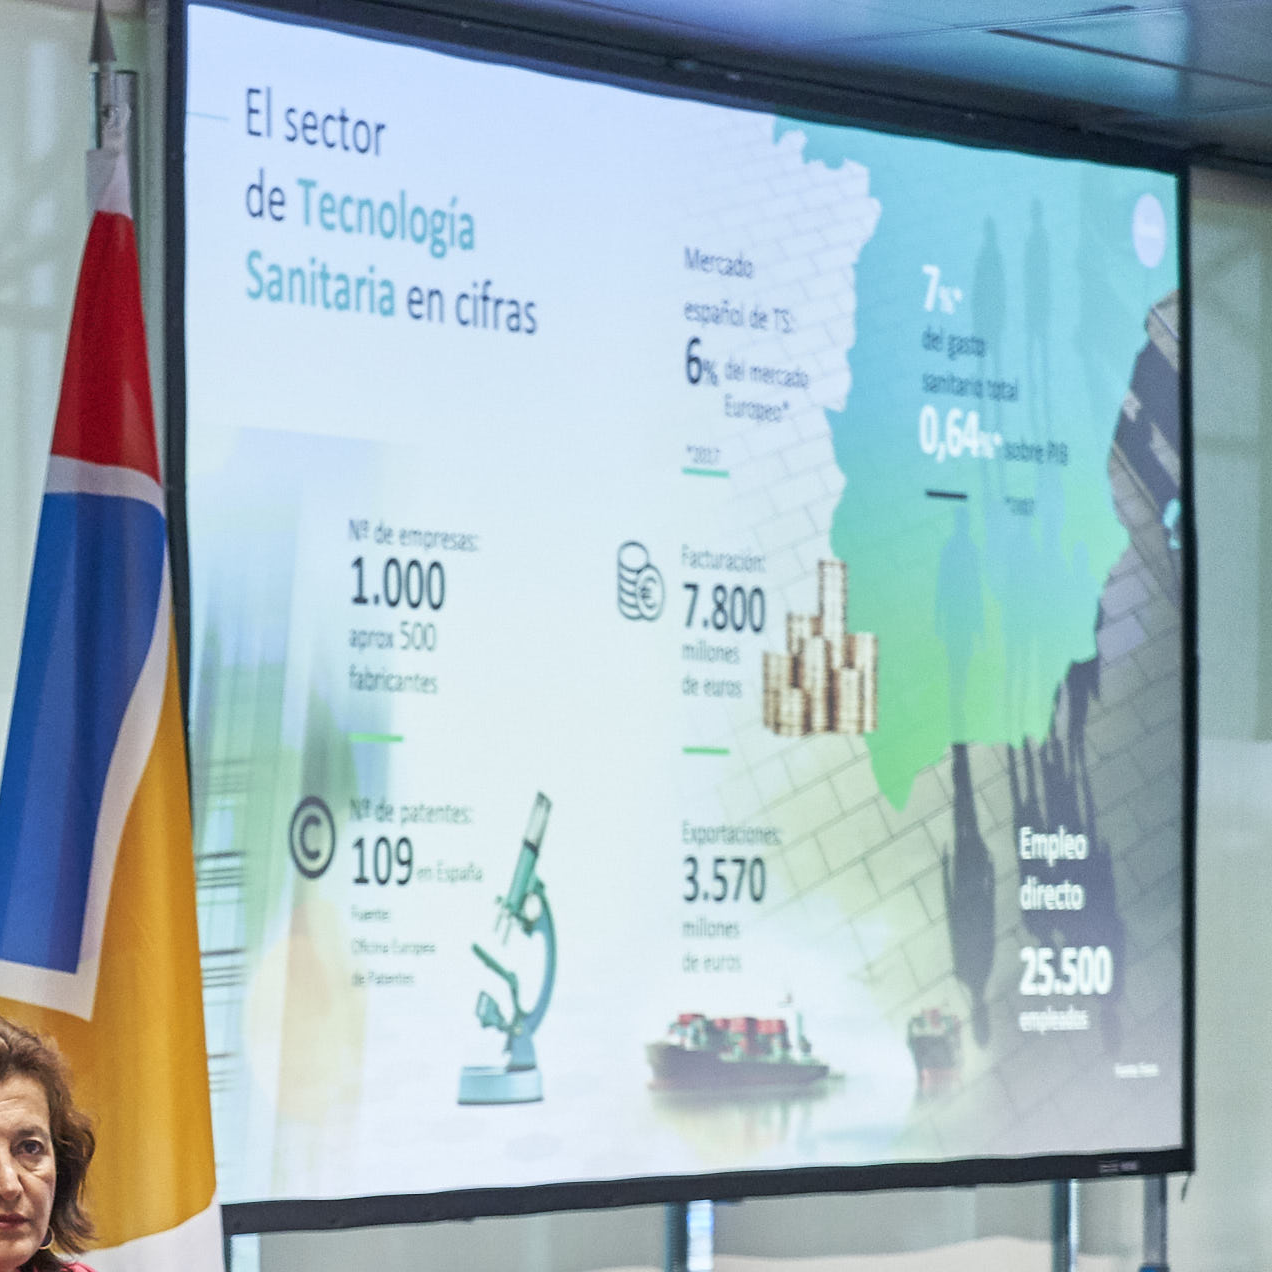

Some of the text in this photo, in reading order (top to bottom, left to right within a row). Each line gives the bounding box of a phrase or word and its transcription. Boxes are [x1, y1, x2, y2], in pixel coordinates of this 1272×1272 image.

[245, 86, 386, 156] El sector
[245, 168, 476, 259] de Tecnología
[684, 246, 753, 279] Mercado
[245, 250, 538, 336] Sanitaria en cifras
[684, 298, 744, 328] español
[750, 303, 768, 330] de
[685, 336, 719, 386] 6%
[749, 364, 810, 389] mercado
[373, 521, 394, 545] de
[351, 557, 446, 611] 1.000
[682, 583, 766, 633] 7.800
[349, 621, 437, 653] aprox 500
[681, 640, 740, 665] millones
[349, 665, 438, 694] fabricantes
[681, 674, 742, 699] de euros
[375, 797, 393, 823] de
[353, 836, 413, 885] 109
[437, 859, 483, 884] España
[1020, 826, 1089, 867] Empleo
[682, 856, 766, 903] 3.570
[1020, 875, 1085, 910] directo
[681, 917, 740, 940] millones
[681, 951, 742, 975] de euros
[1019, 945, 1113, 996] 25.500
